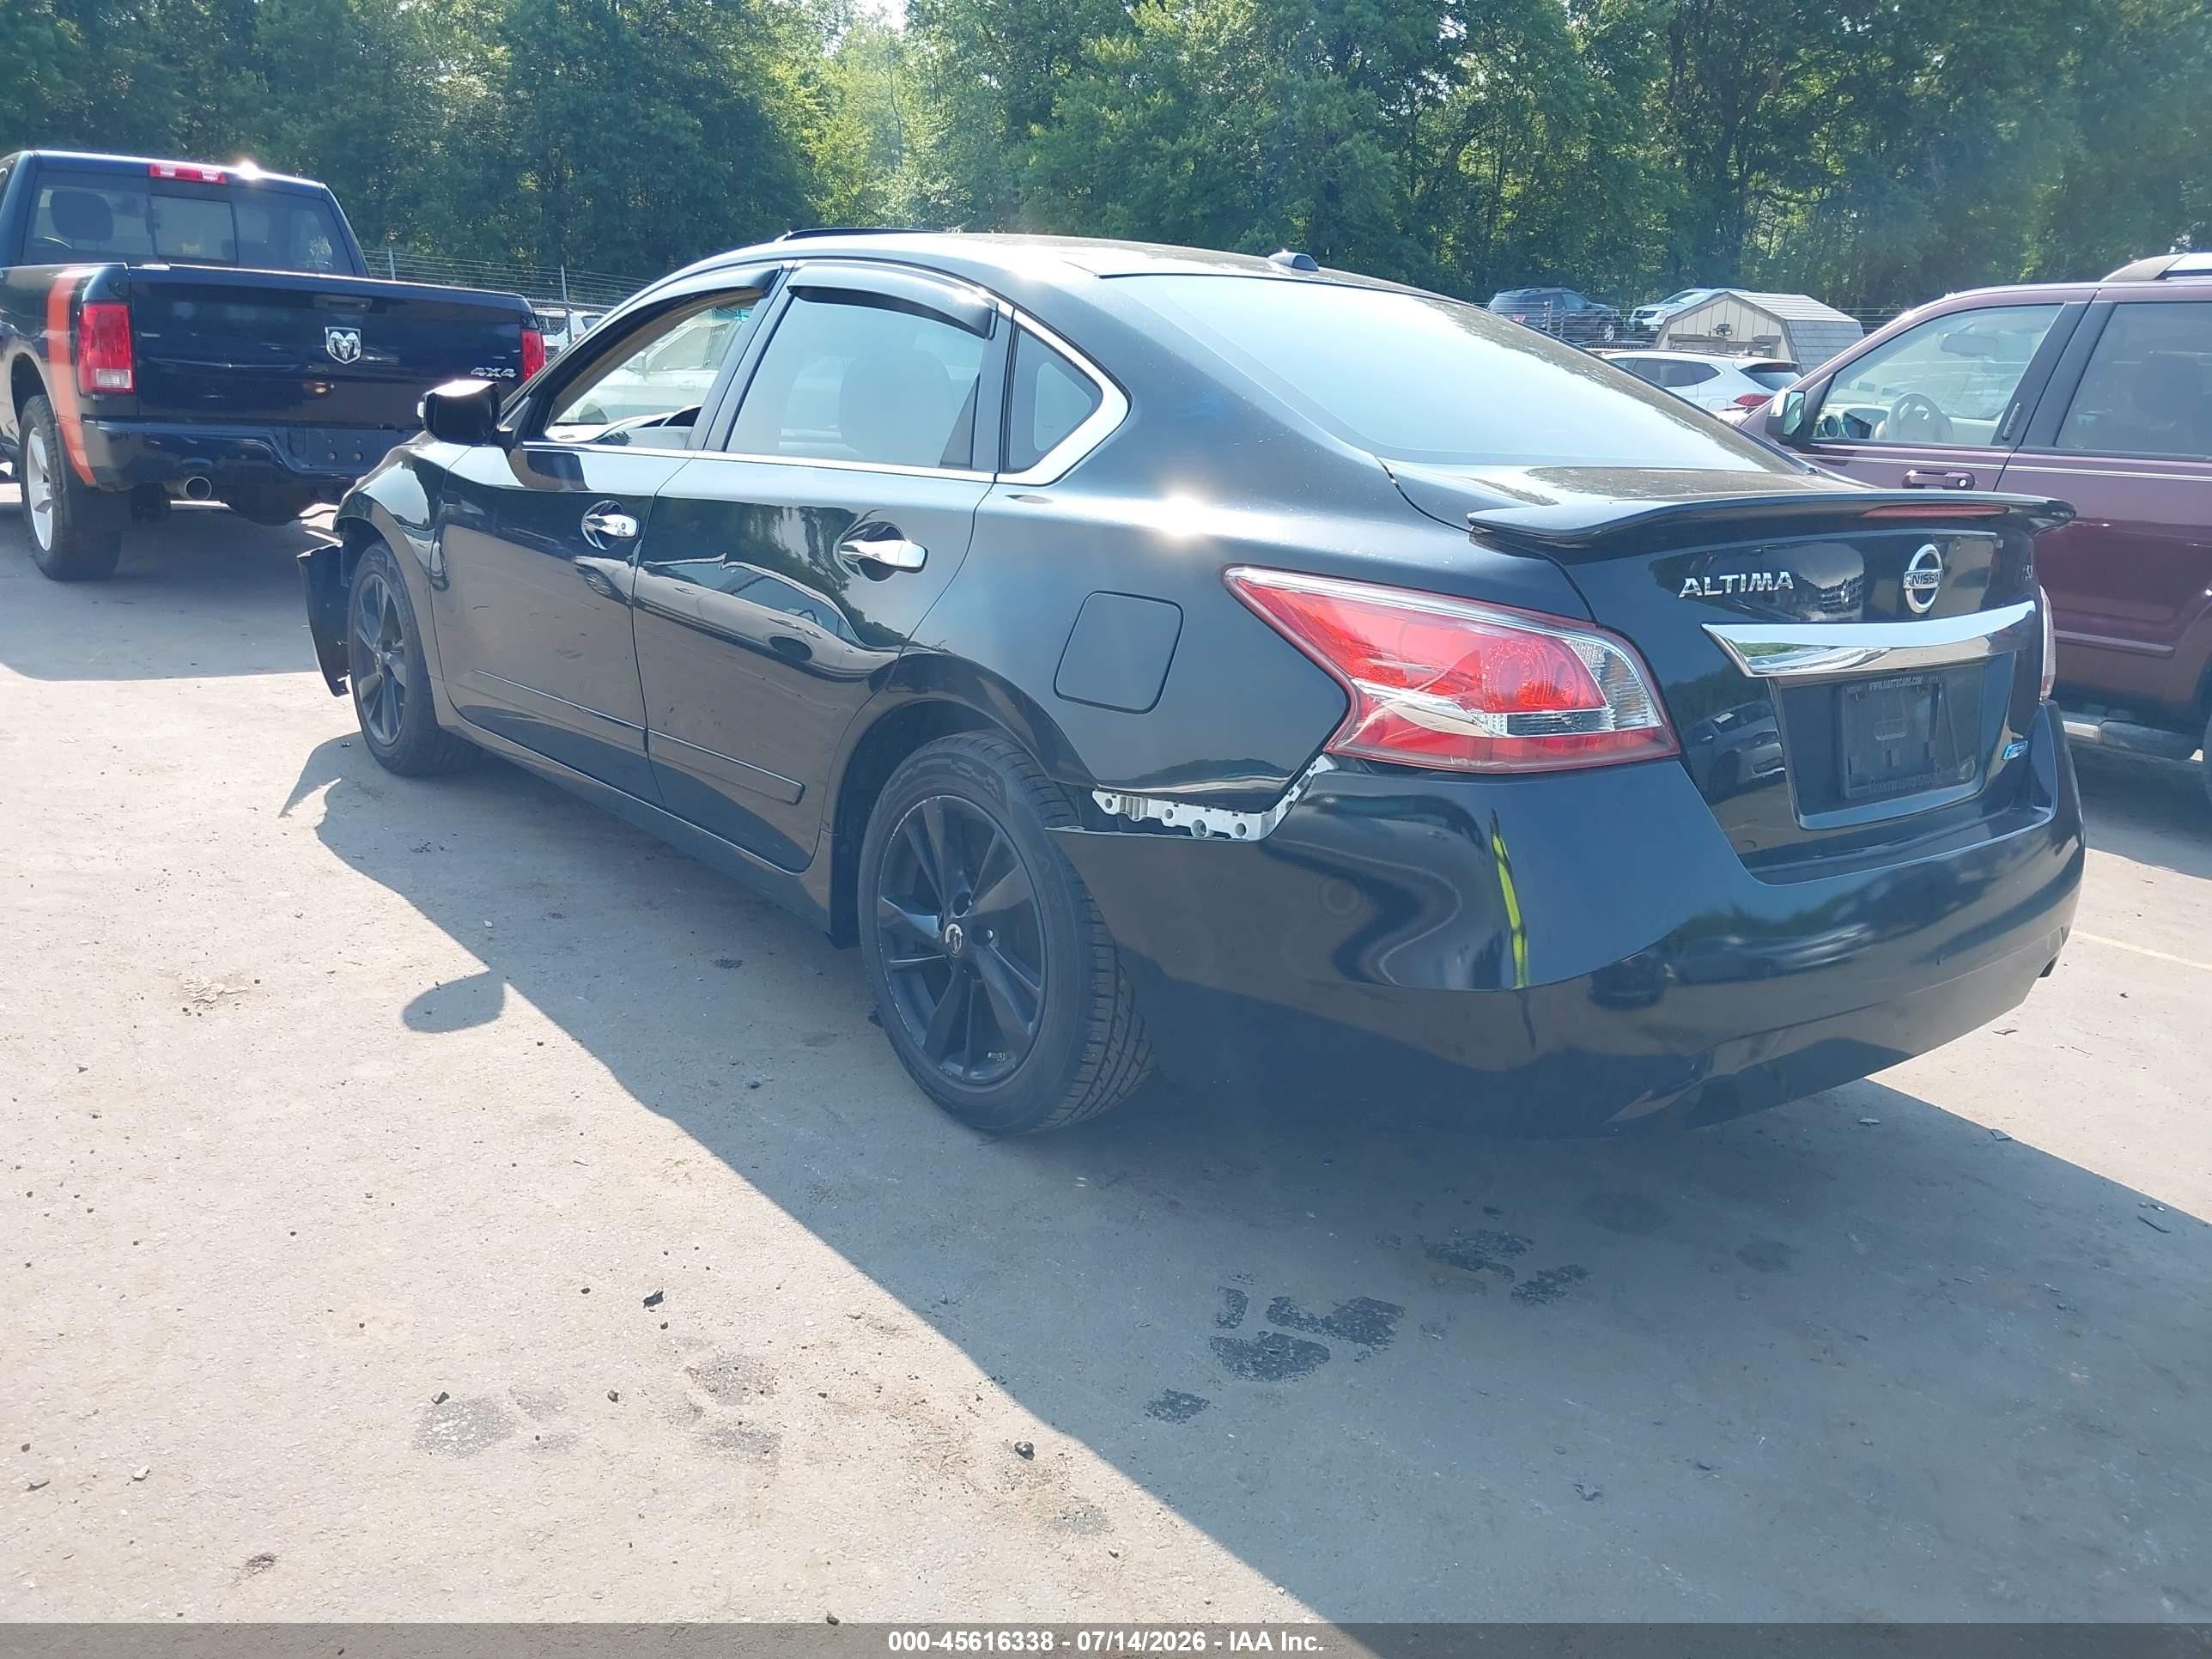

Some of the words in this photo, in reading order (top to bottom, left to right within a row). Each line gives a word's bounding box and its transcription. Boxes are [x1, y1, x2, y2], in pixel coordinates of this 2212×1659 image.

[471, 368, 517, 379] 4X4
[1678, 571, 1795, 599] ALTIMA
[1911, 574, 1940, 586] NISSA
